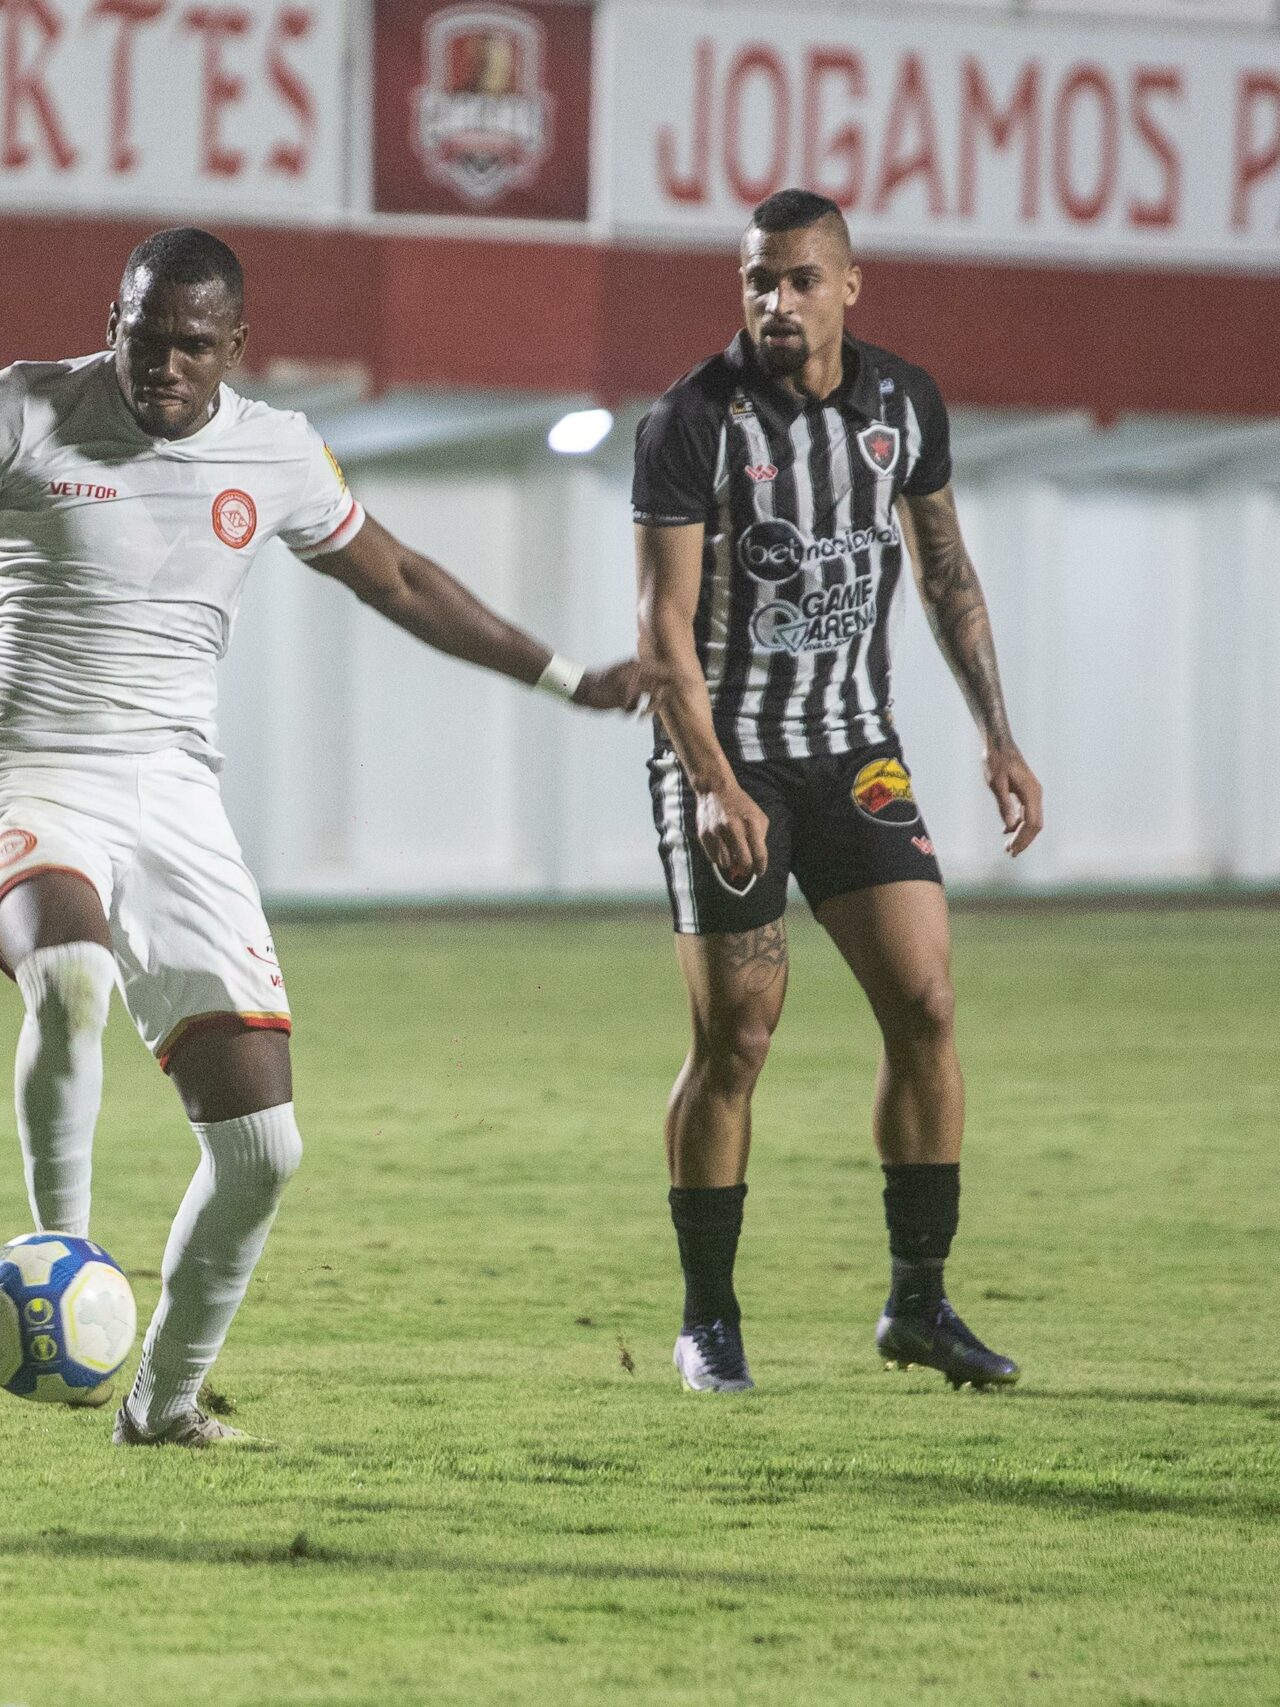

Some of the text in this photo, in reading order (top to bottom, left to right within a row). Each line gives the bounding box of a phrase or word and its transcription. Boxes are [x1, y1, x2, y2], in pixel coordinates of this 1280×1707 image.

[654, 36, 1280, 235] JOGAMOS P
[49, 480, 118, 499] VETTOR
[746, 536, 801, 565] bet
[801, 576, 874, 619] GAME
